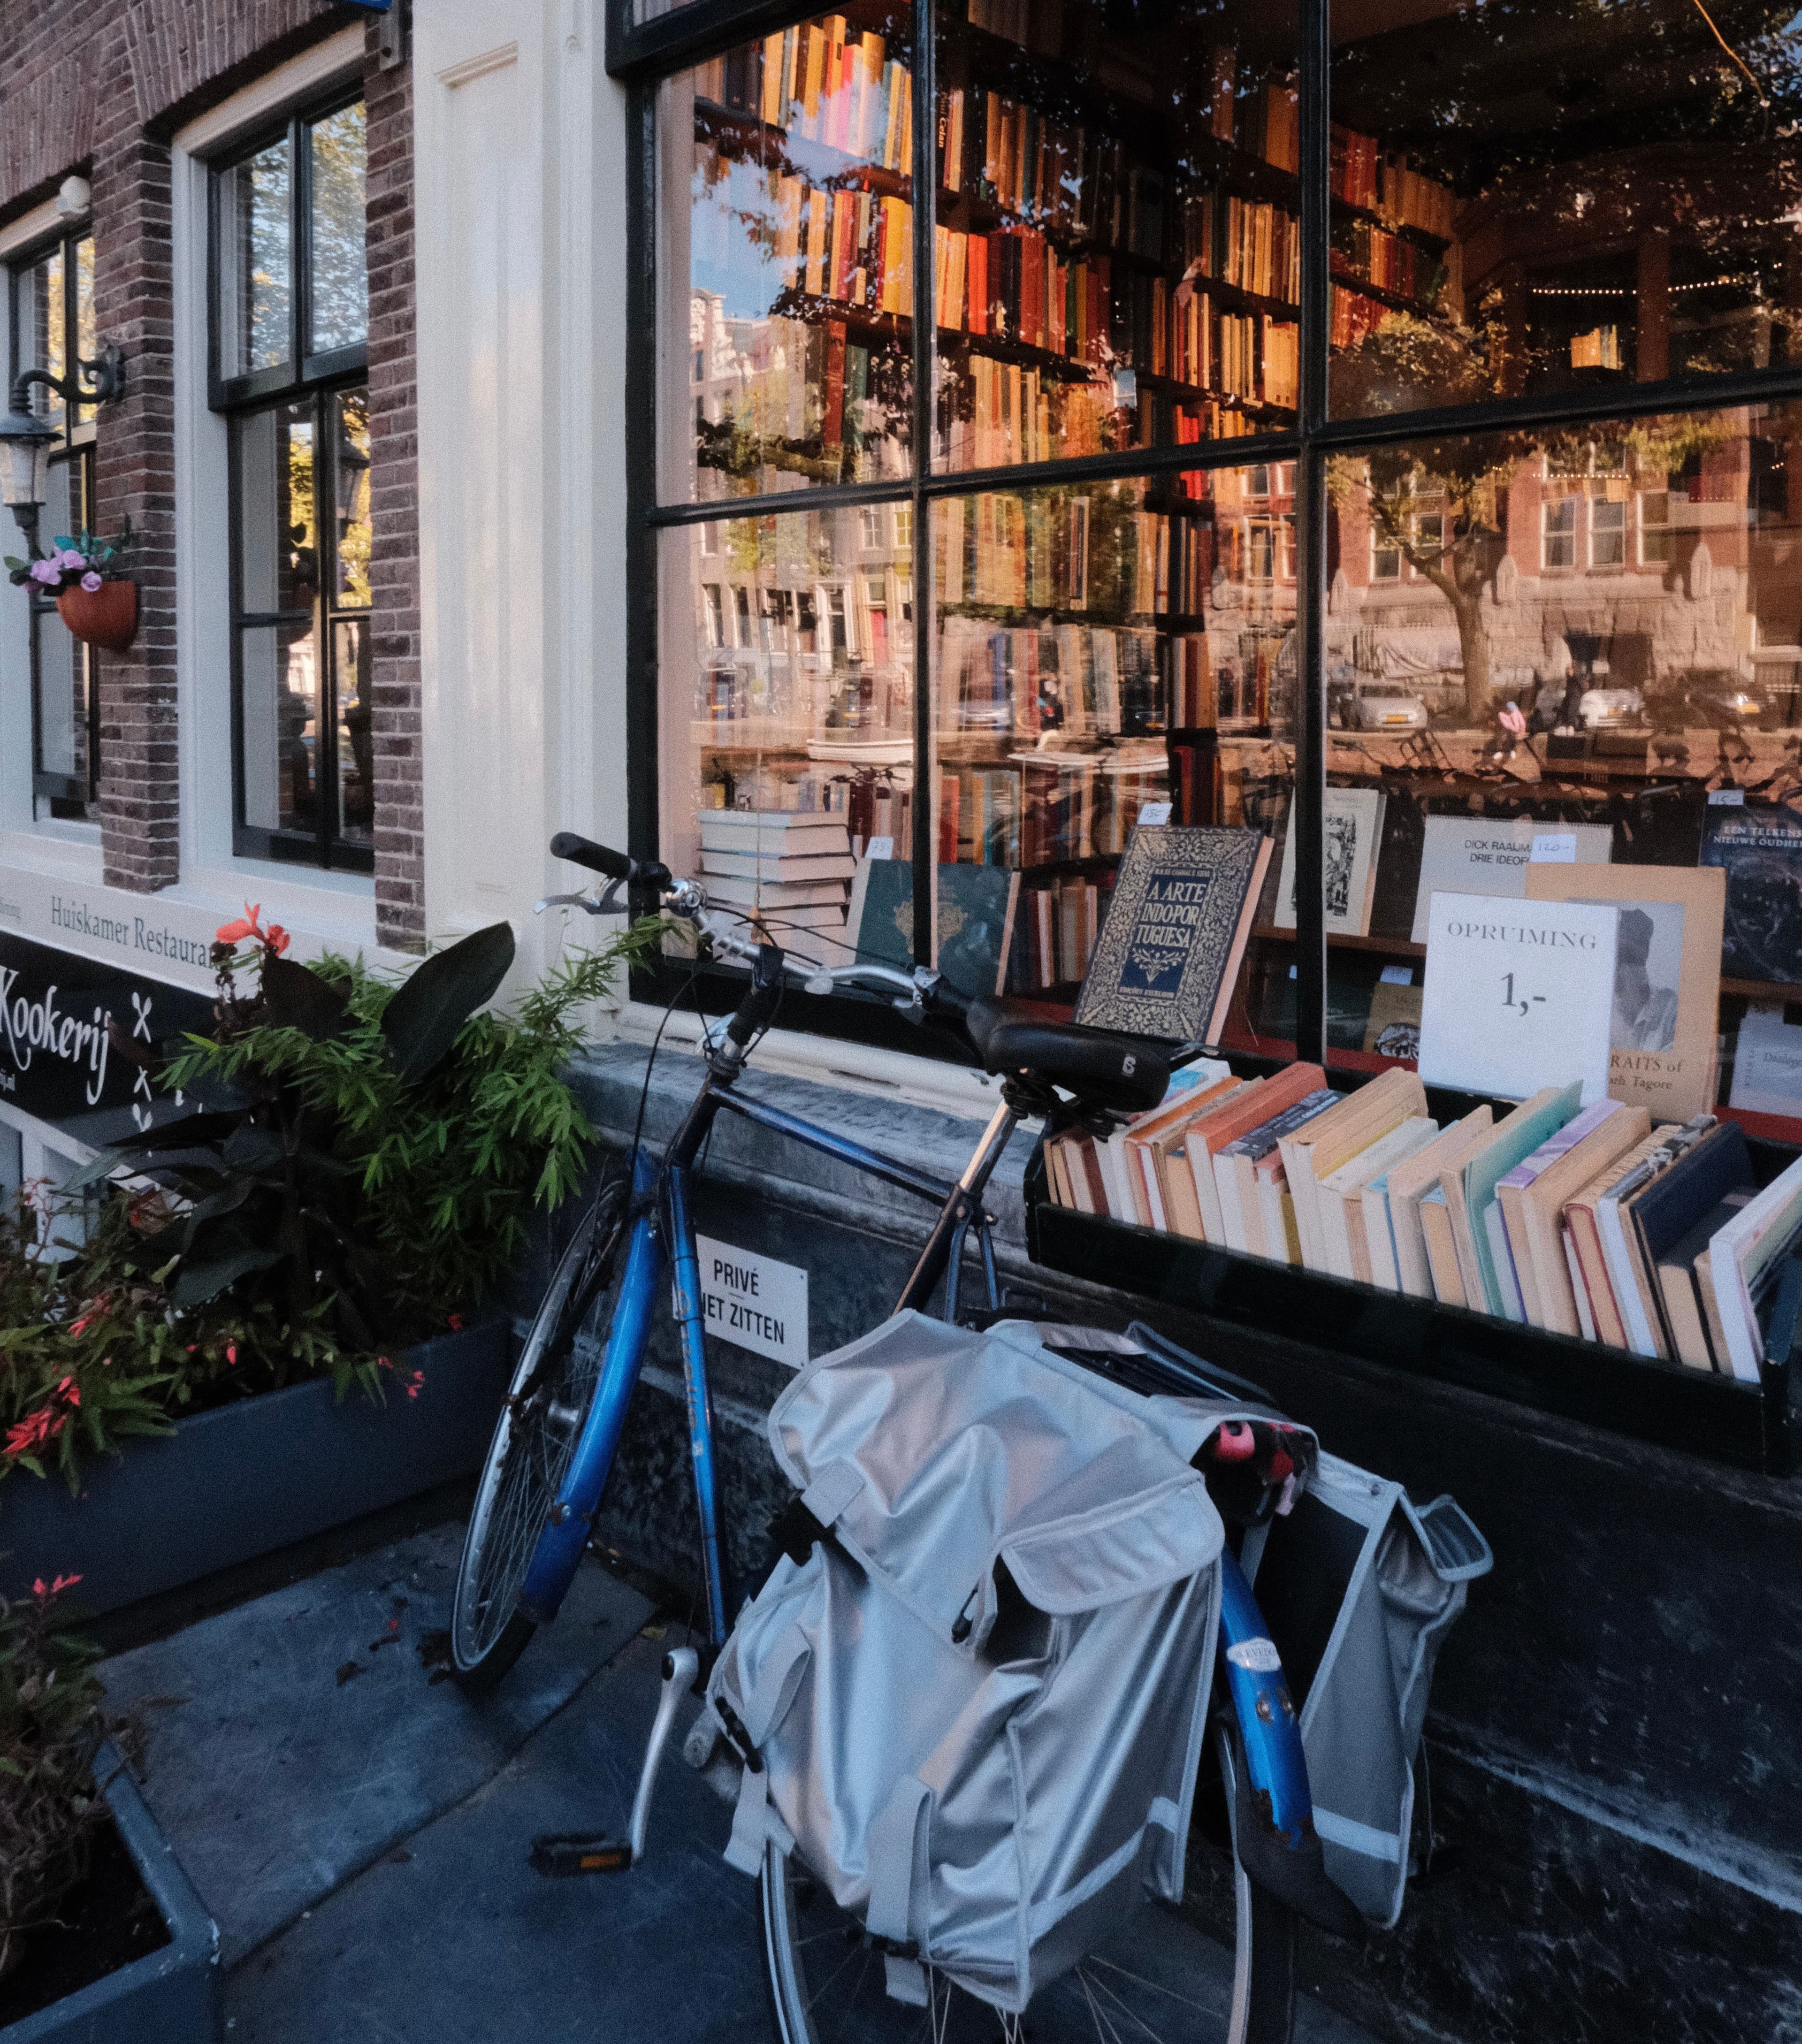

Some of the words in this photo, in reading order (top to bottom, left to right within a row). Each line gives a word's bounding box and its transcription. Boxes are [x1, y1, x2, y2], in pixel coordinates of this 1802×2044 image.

[1465, 840, 1488, 850] DICK
[1713, 835, 1756, 846] NIEUWE
[1470, 853, 1493, 863] DRIE
[1496, 854, 1530, 866] IDEOF
[1160, 881, 1207, 903] ARTE
[51, 896, 130, 946] Huiskamer
[1135, 924, 1191, 949] TUGUESA
[1448, 922, 1596, 949] OPRUIMING
[0, 964, 112, 1106] Kookerij
[1666, 1060, 1683, 1073] of
[1633, 1076, 1672, 1092] Tagore
[713, 1259, 759, 1297] PRIVÉ
[729, 1303, 785, 1345] ZITTEN
